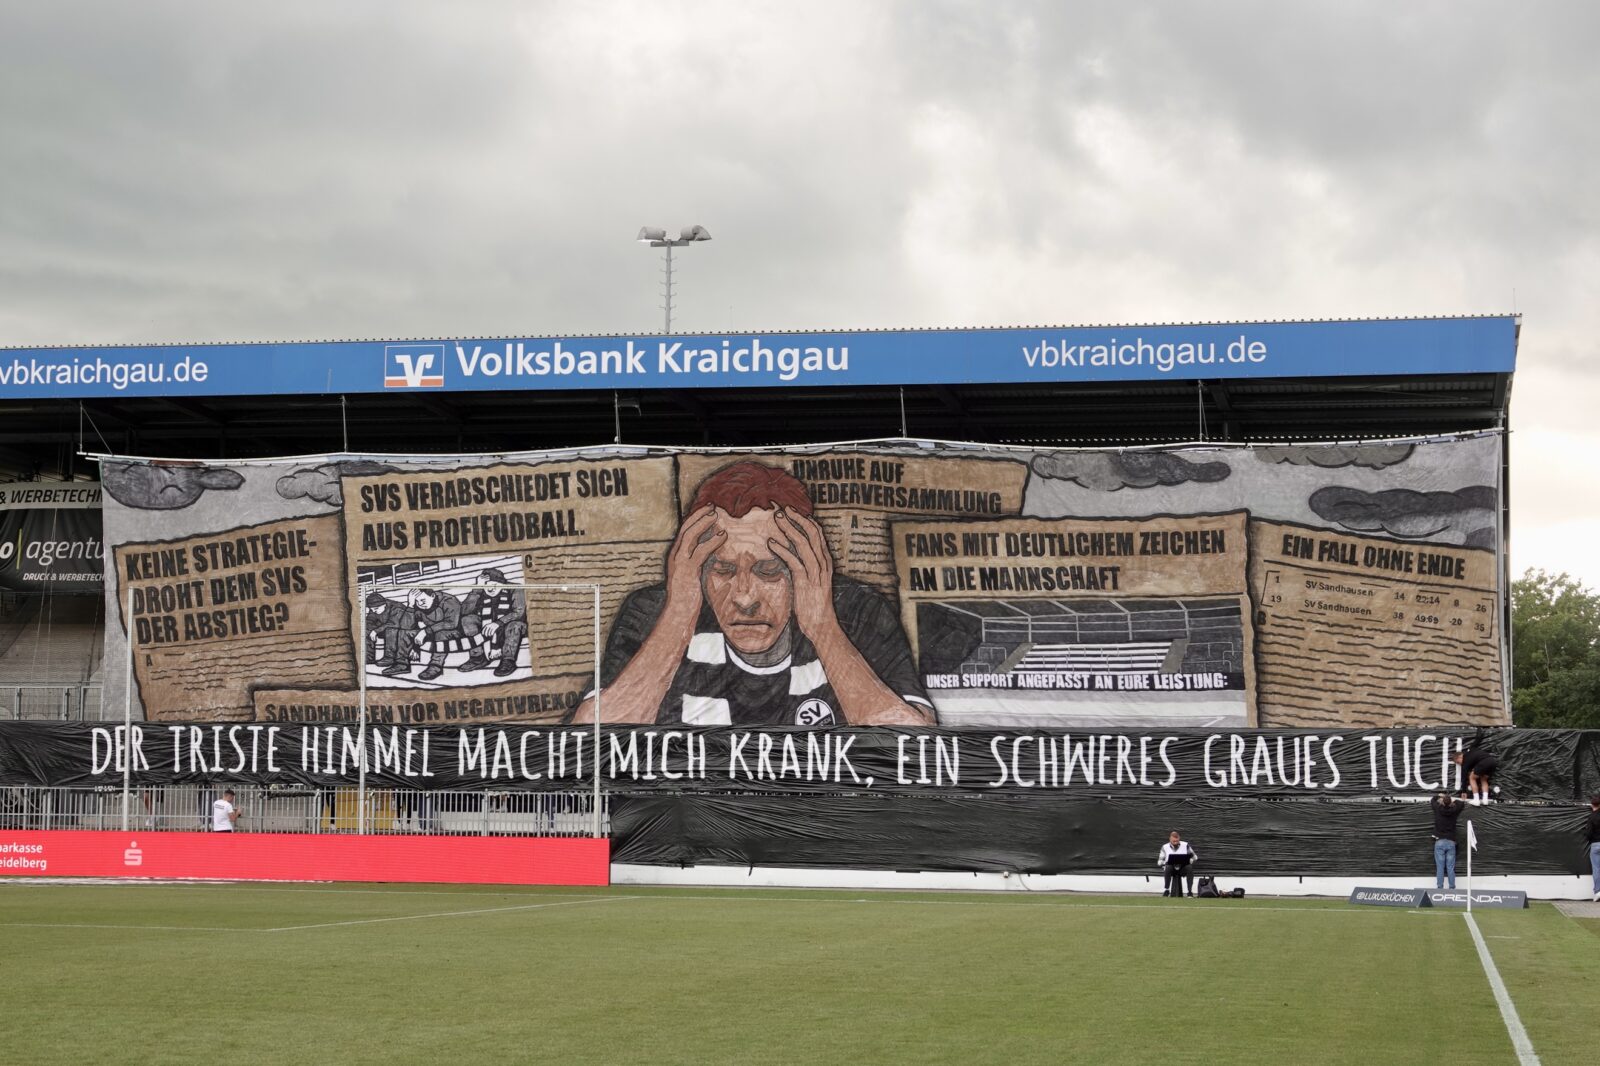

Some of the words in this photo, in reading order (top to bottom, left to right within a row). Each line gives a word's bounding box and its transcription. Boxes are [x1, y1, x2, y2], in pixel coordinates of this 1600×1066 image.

[457, 341, 646, 377] Volksbank
[658, 339, 849, 380] Kraichgau
[1023, 336, 1267, 371] vbkraichgau.de
[0, 356, 208, 390] vbkraichgau.de
[793, 458, 865, 480] UNRUHE
[870, 460, 905, 484] AUF
[361, 483, 401, 513] SVS
[405, 472, 570, 511] VERABSCHIEDET
[576, 468, 628, 497] SICH
[362, 521, 408, 550] AUS
[905, 533, 956, 557] FANS
[962, 532, 1000, 557] MIT
[1005, 532, 1134, 557] DEUTLICHEM
[1139, 530, 1226, 555] ZEICHEN
[125, 548, 189, 581] KEINE
[193, 530, 317, 572] STRATEGIE-
[1281, 534, 1314, 560] EIN
[1318, 541, 1359, 566] FALL
[1364, 546, 1413, 573] OHNE
[1417, 552, 1465, 580] ENDE
[23, 573, 48, 581] DRUCK
[132, 581, 205, 615] DROHT
[210, 572, 258, 605] DEM
[261, 566, 308, 596] SVS
[910, 567, 937, 591] AN
[943, 567, 977, 592] DIE
[980, 566, 1120, 591] MANNSCHAFT
[1271, 595, 1282, 603] 19
[1304, 599, 1316, 608] SV
[1317, 601, 1372, 615] Sandhausen
[1392, 611, 1404, 620] 38
[1305, 580, 1317, 589] SV
[1319, 583, 1374, 597] Sandhausen
[1394, 592, 1405, 601] 14
[1475, 603, 1487, 613] 26
[135, 616, 179, 644] DER
[184, 602, 289, 640] ABSTIEG?
[926, 674, 960, 689] UNSER
[962, 674, 1014, 688] SUPPORT
[1017, 673, 1090, 689] ANGEPASST
[1095, 674, 1113, 689] AN
[1117, 674, 1150, 690] EURE
[1154, 673, 1228, 689] LEISTUNG:
[398, 702, 440, 722] VOR
[90, 726, 149, 775] DER
[169, 726, 280, 773] TRISTE
[302, 726, 435, 776] HIMMEL
[458, 728, 588, 780] MACHT
[610, 731, 706, 780] MICH
[729, 732, 874, 788] KRANK,
[897, 735, 959, 786] EIN
[989, 734, 1180, 788] SCHWERES
[1204, 734, 1344, 788] GRAUES
